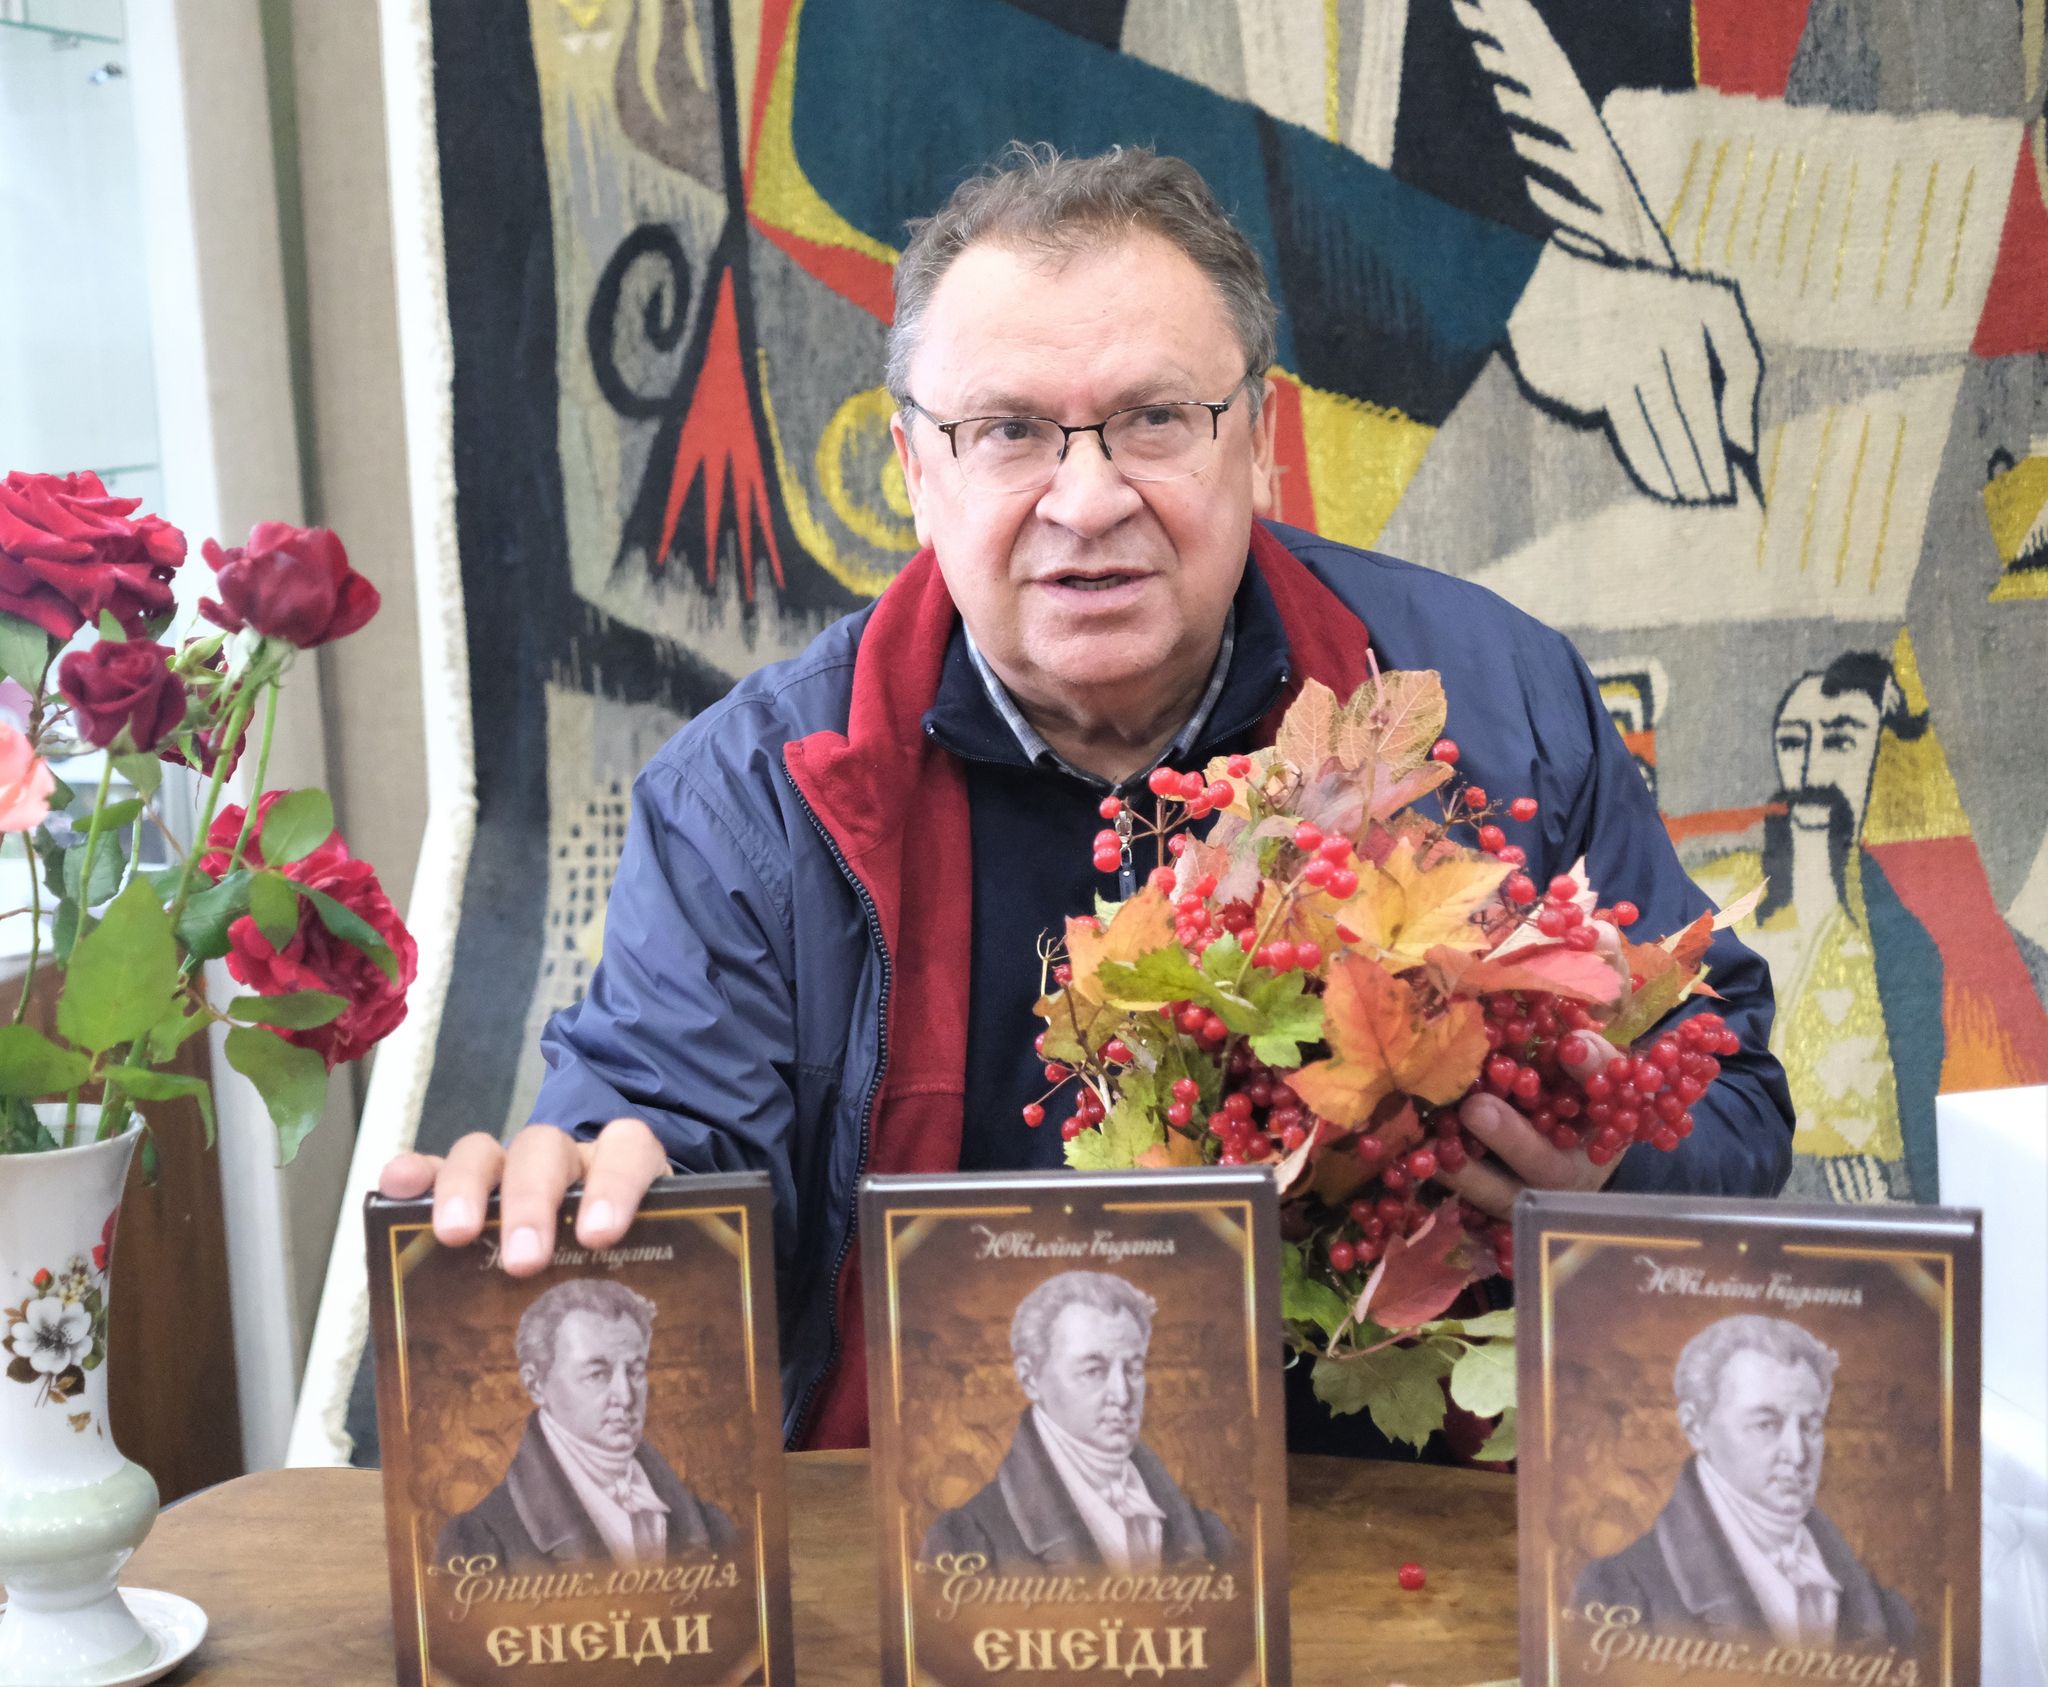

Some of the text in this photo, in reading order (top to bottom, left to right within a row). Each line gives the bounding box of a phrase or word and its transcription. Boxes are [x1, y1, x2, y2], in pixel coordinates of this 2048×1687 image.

[427, 1553, 742, 1622] Енциклопедія
[914, 1552, 1239, 1621] Енциклопедія
[1561, 1601, 1921, 1687] Енциклопедія
